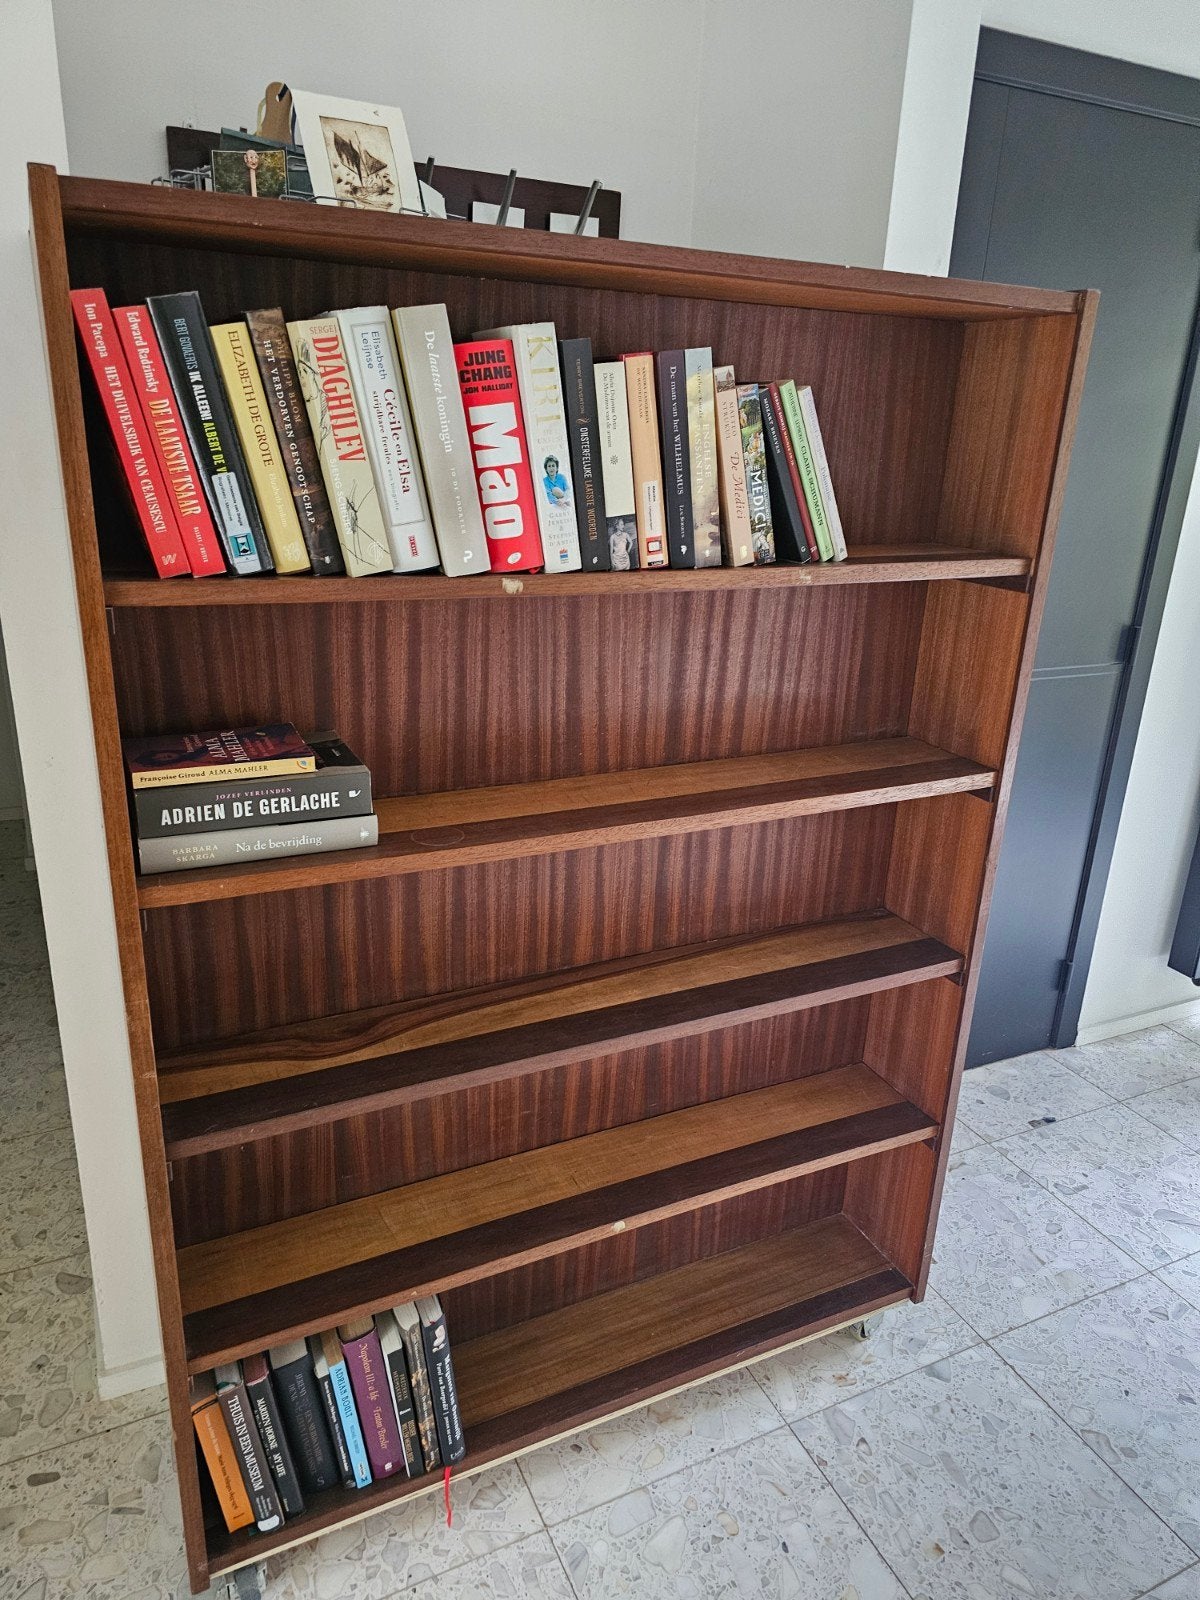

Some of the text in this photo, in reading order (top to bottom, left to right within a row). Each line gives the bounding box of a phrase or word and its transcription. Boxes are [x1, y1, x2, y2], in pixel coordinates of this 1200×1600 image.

[361, 332, 374, 369] Leijnse
[371, 331, 387, 380] Elisabeth
[464, 350, 505, 366] JUNG
[174, 318, 225, 465] BERT GOVAERTS IK ALLEEN! ALBERT DE
[274, 338, 301, 423] PHILIPP BLOM
[425, 331, 454, 453] De laatste koningin
[459, 366, 512, 383] CHANG
[482, 383, 512, 392] HALLIDAY
[84, 303, 166, 533] Ion Pacepa HET DUIVELSRIJK VAN CEAUSESCU
[126, 311, 201, 516] Edward Radzinsky DE LAATSTE TSAAR
[228, 330, 274, 467] ELIZABETH DE GROTE
[312, 335, 366, 461] DIAGHILEV
[372, 391, 385, 433] strijdbare
[263, 339, 315, 523] HET VERDORVEN GENOOTSCHAP
[384, 388, 411, 493] Cécile en Elsa
[670, 366, 677, 379] De
[674, 434, 684, 495] WILHELMUS
[764, 398, 780, 454] MOZART BRIEVEN
[469, 402, 524, 540] Mao
[693, 424, 704, 494] PASSANTEN
[703, 424, 712, 477] ENGELSE
[580, 427, 597, 540] ONSTERFELIJKE LAATSTE WOORDEN
[730, 452, 745, 519] De Medici
[750, 469, 767, 530] MEDICI
[801, 445, 811, 476] CLARA
[808, 477, 824, 526] SCHUMANN
[205, 738, 227, 758] ALMA
[220, 730, 250, 761] MAHLER
[140, 774, 177, 783] Françoise
[208, 768, 232, 776] ALMA
[234, 764, 269, 774] MAHLER
[216, 787, 292, 801] JOZEF VERLINDEN
[161, 792, 340, 826] ADRIEN DE GERLACHE
[172, 844, 218, 856] BARBARA
[176, 853, 215, 862] SKARGA
[236, 834, 322, 853] Na de bevrijding
[358, 1343, 372, 1373] Napoleon
[365, 1373, 375, 1385] III:
[228, 1395, 245, 1425] THUIS
[335, 1368, 347, 1395] ADRIAN
[341, 1395, 353, 1418] BOULT
[367, 1390, 379, 1401] life
[236, 1423, 248, 1436] IN
[239, 1434, 253, 1454] EEN
[257, 1397, 271, 1427] MARILYN
[265, 1425, 278, 1450] HORNE
[244, 1452, 264, 1491] MUSEUM
[273, 1452, 286, 1477] MY LIFE
